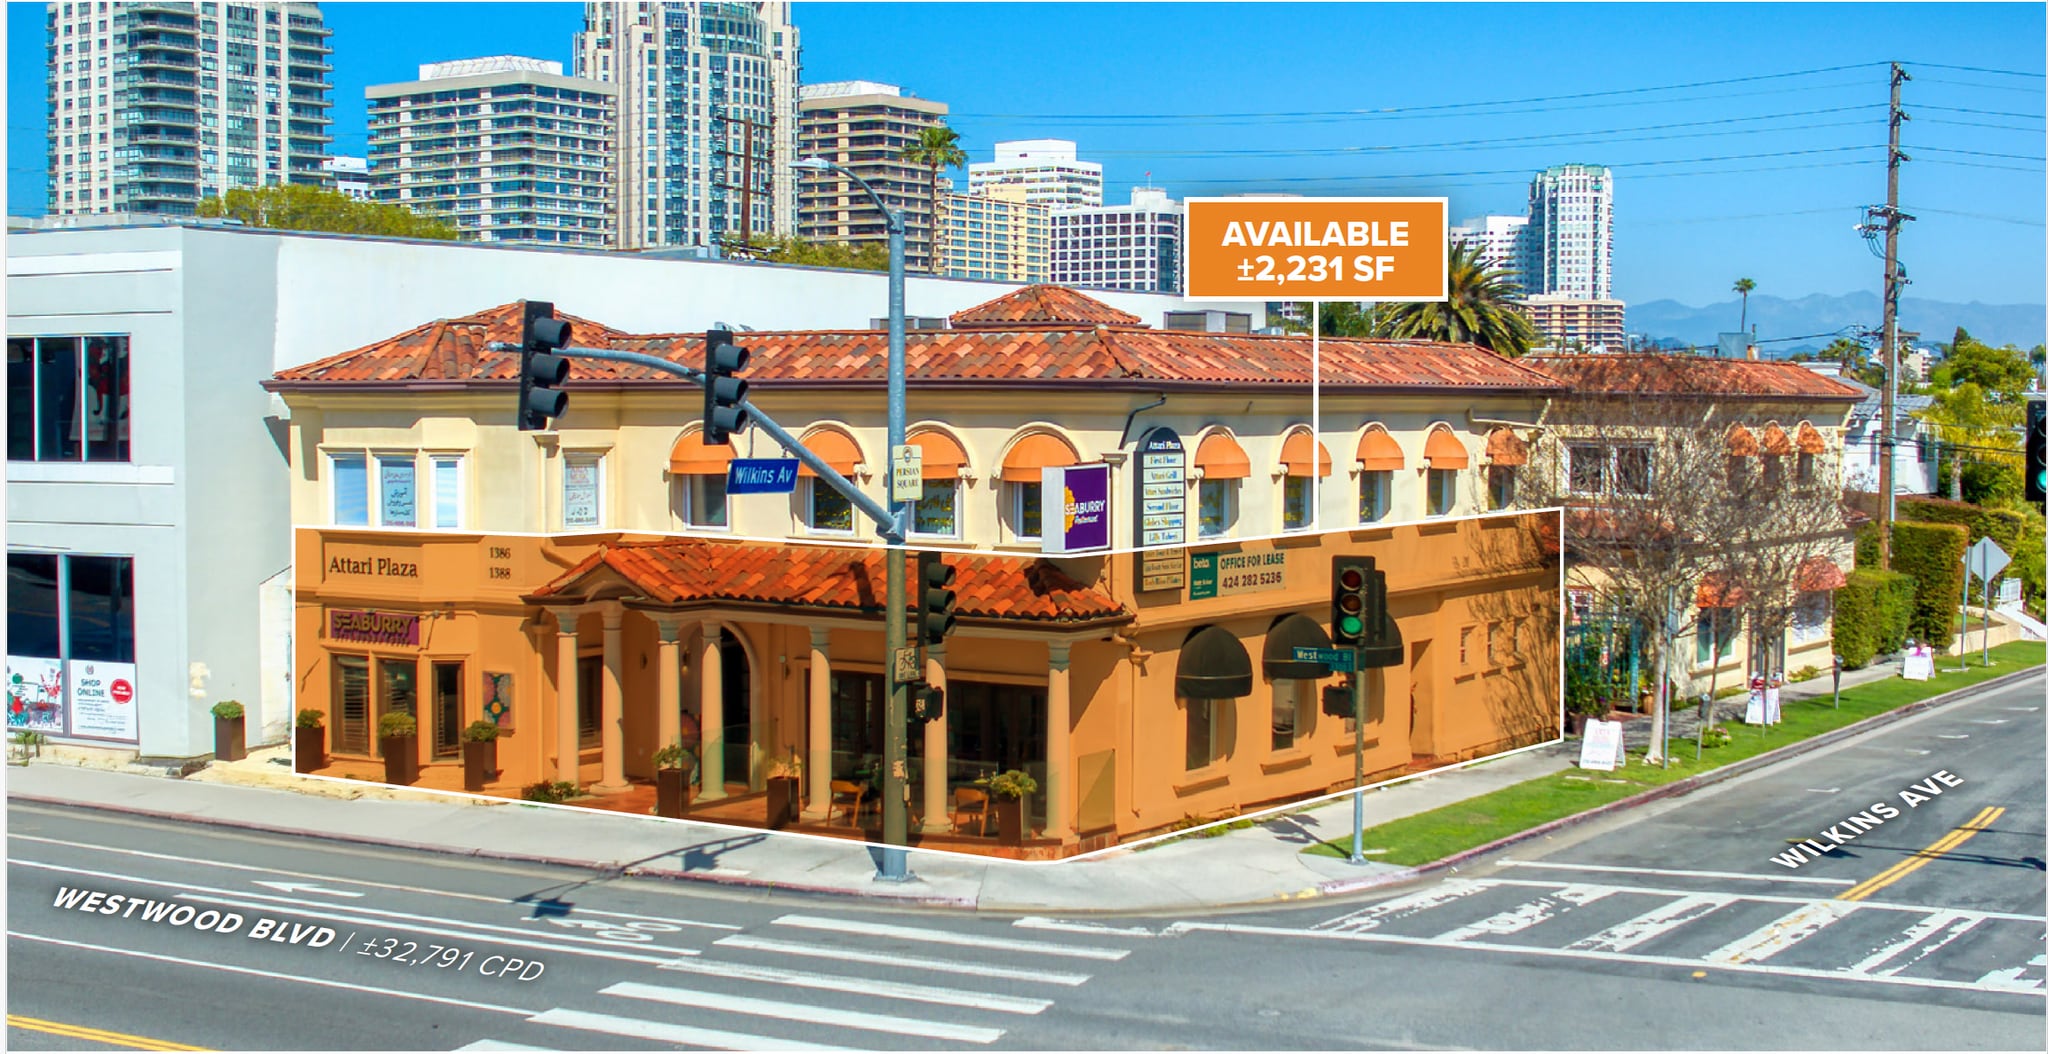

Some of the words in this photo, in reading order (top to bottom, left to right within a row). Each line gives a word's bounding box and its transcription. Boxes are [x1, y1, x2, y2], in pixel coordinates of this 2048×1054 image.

[735, 466, 775, 484] Wilkins
[776, 465, 793, 484] Av
[896, 467, 920, 477] PERSIAN
[896, 479, 918, 489] SQUARE
[1065, 500, 1105, 515] SEABURRY
[489, 547, 511, 559] 1386
[329, 556, 373, 575] Attari
[378, 557, 418, 578] Plaza
[1221, 557, 1246, 570] OFFICE
[1247, 555, 1261, 568] FOR
[1263, 553, 1284, 565] LEASE
[489, 567, 511, 580] 1388
[1222, 576, 1239, 589] 424
[1242, 574, 1257, 588] 282
[1260, 571, 1281, 586] 5236
[334, 613, 411, 634] SEABURRY
[81, 678, 101, 687] SHOP
[77, 687, 105, 697] ONLINE
